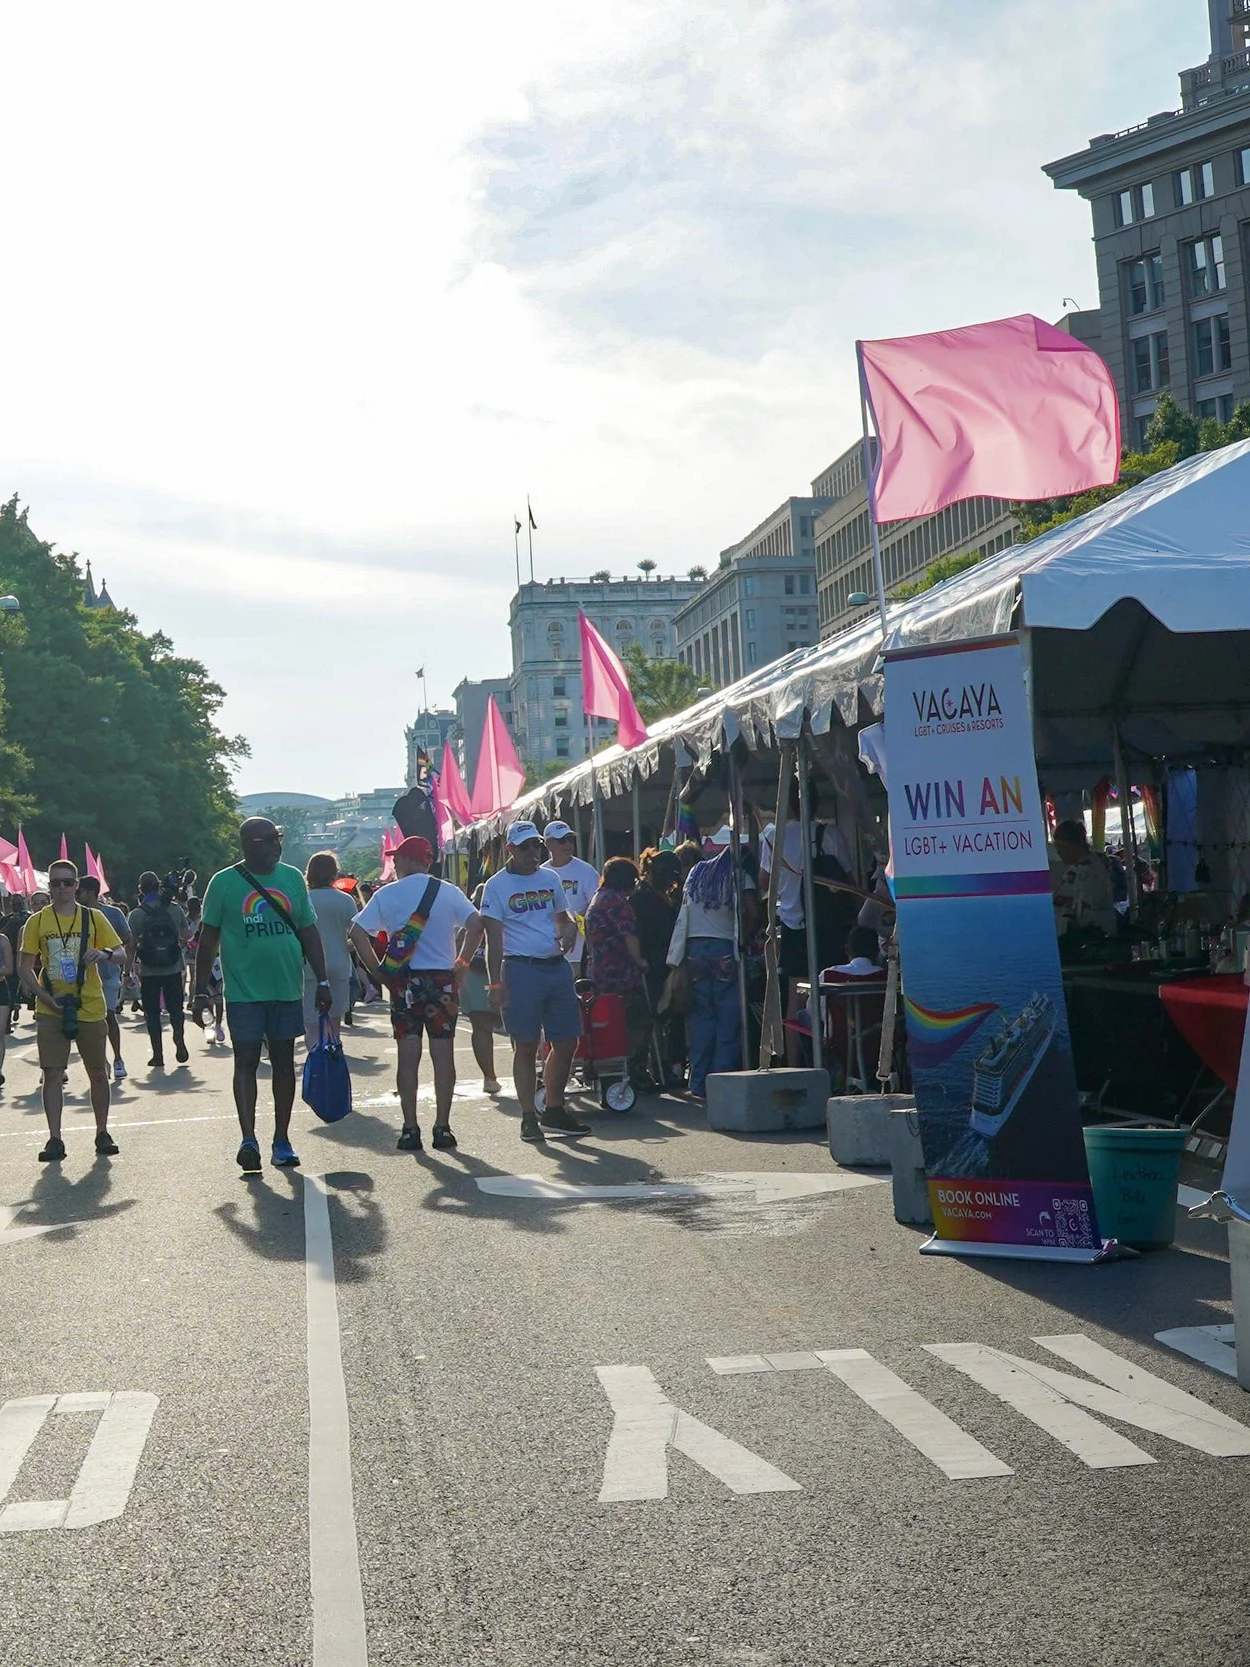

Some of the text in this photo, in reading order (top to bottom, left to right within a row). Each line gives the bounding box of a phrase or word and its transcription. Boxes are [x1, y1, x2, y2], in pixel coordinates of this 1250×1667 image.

[912, 682, 1003, 722] VACAYA
[914, 726, 936, 737] LGBT+
[936, 722, 966, 735] CRUISES
[971, 718, 1004, 731] RESORTS
[904, 775, 1023, 820] WIN AN
[904, 830, 1033, 856] LGBT+ VACATION
[242, 913, 263, 923] indi
[937, 1189, 1021, 1207] BOOK ONLINE
[1025, 1228, 1055, 1238] SCAN TO
